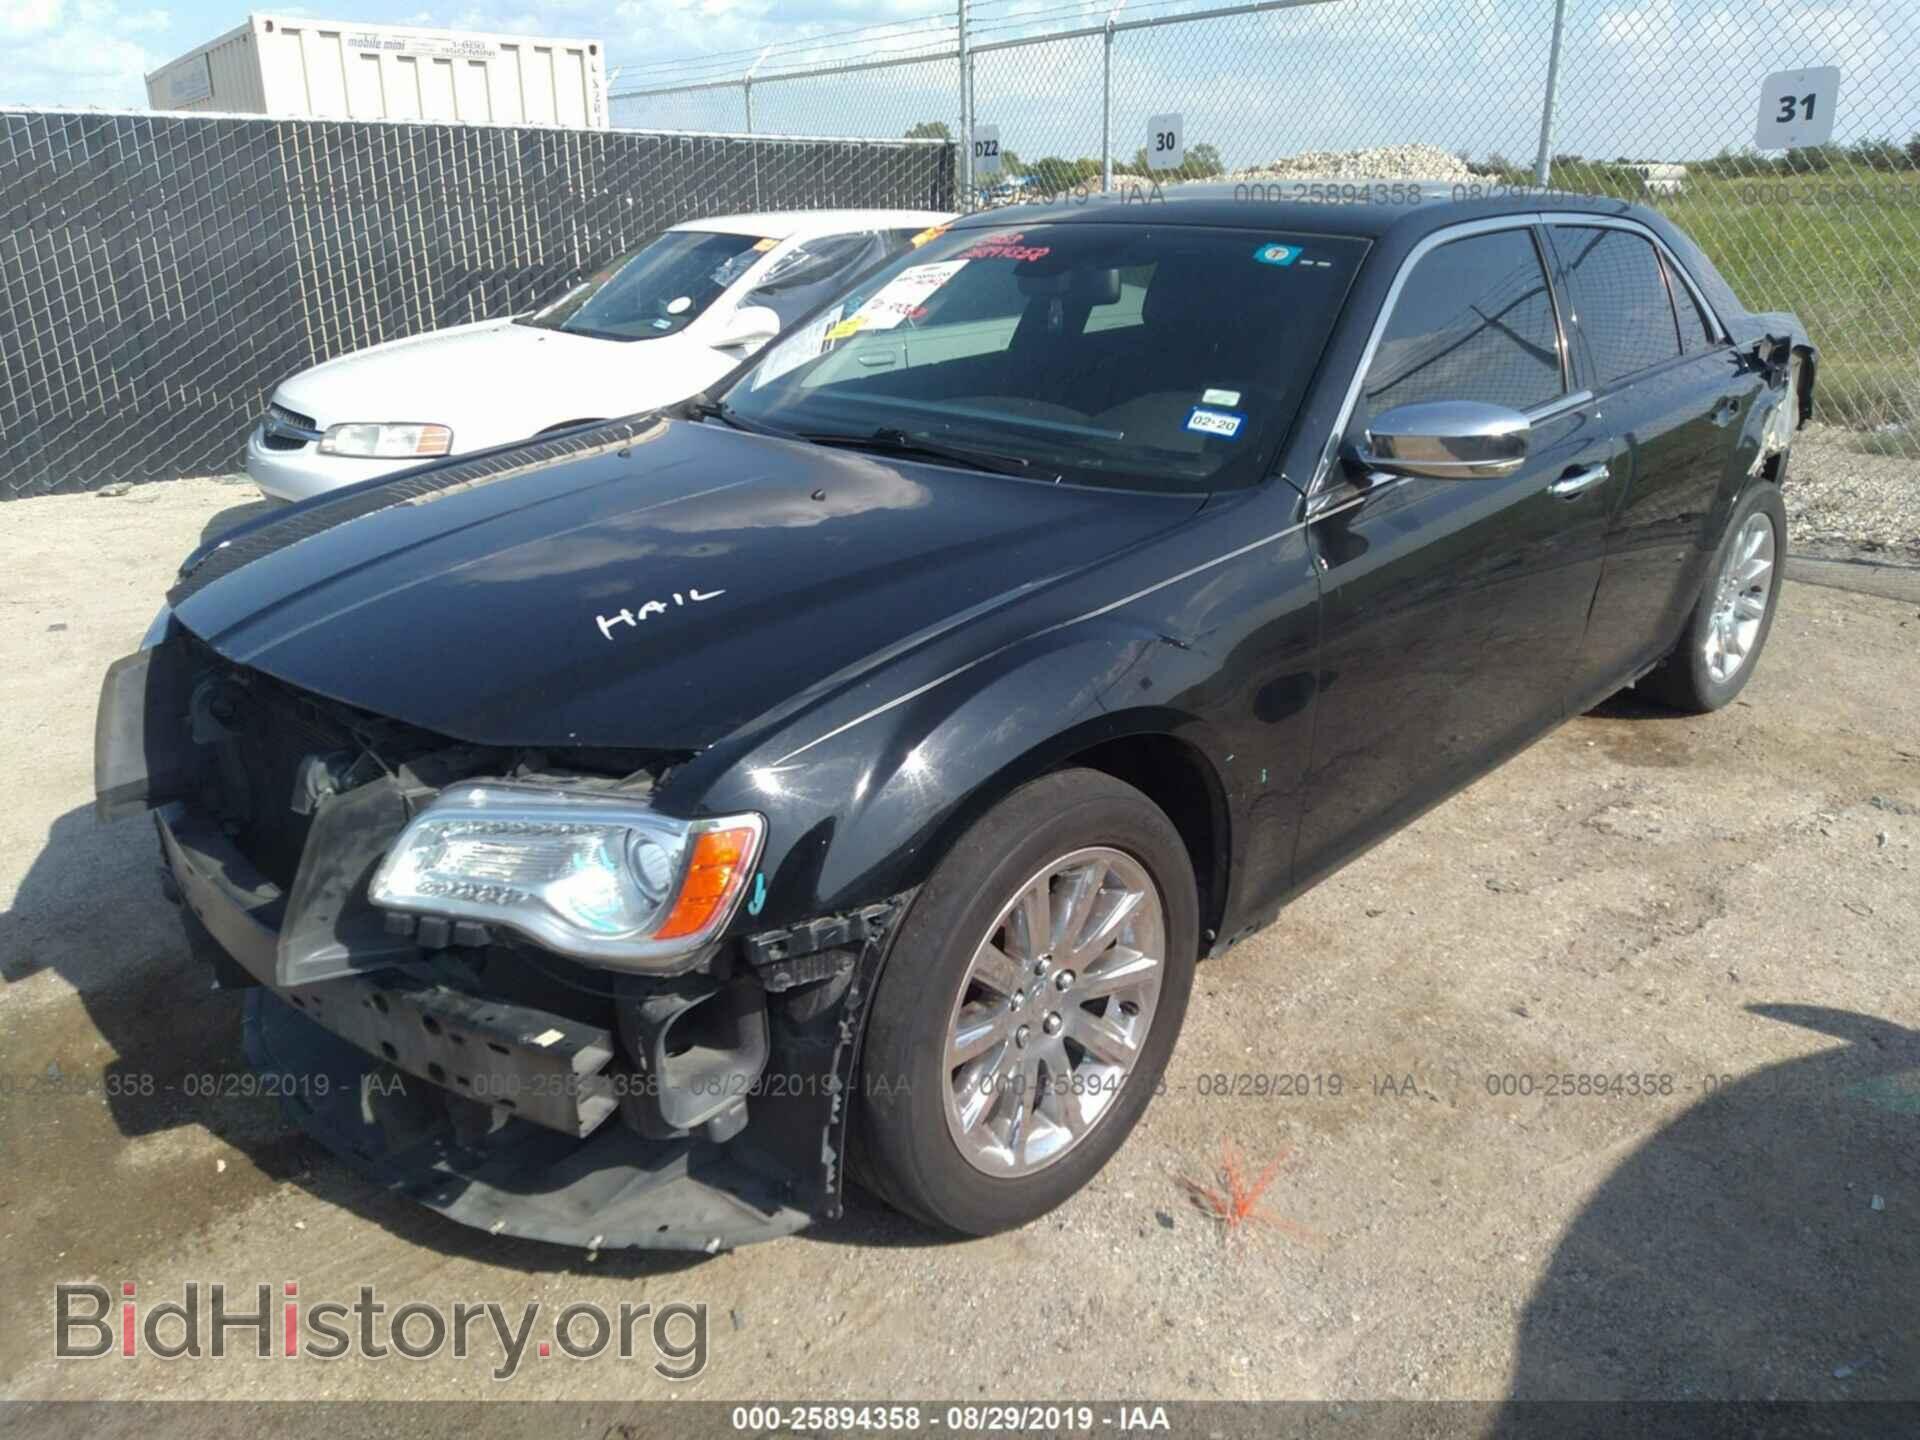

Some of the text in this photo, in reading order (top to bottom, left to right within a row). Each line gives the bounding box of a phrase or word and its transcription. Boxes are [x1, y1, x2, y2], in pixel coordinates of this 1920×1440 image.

[1776, 93, 1817, 123] 31
[975, 140, 998, 157] DZ2
[1156, 132, 1175, 151] 30
[596, 589, 726, 640] HAIL
